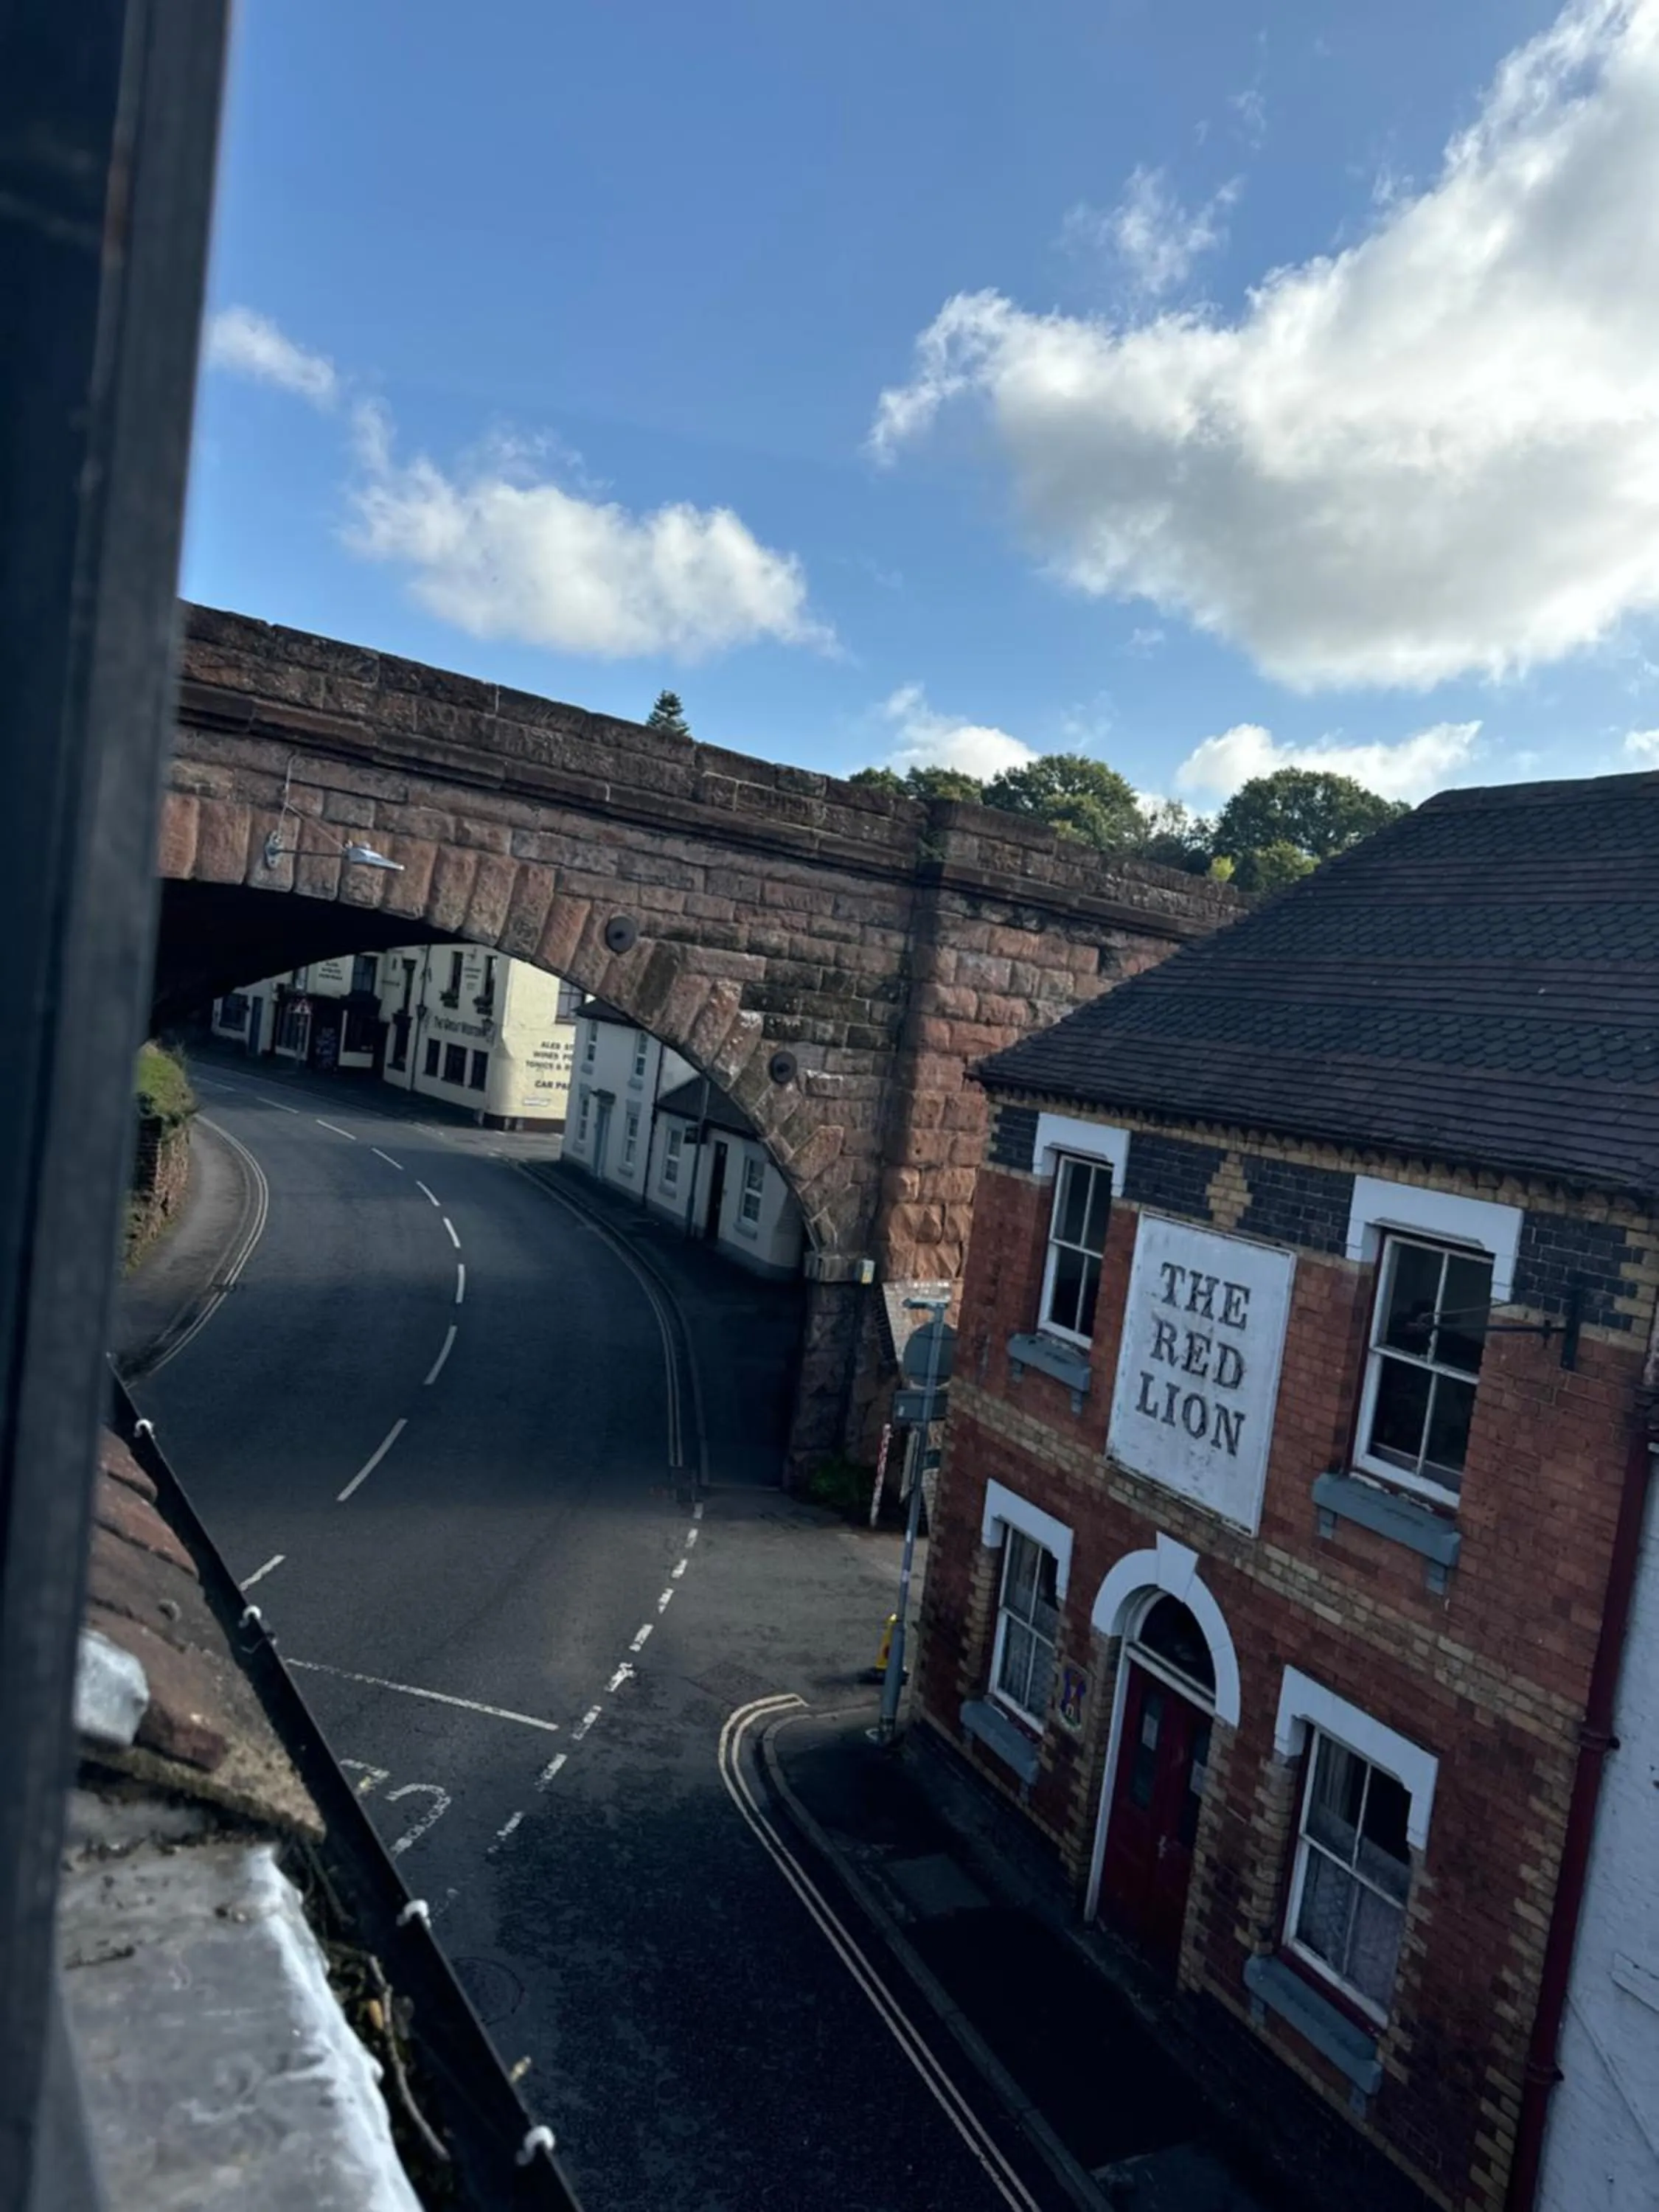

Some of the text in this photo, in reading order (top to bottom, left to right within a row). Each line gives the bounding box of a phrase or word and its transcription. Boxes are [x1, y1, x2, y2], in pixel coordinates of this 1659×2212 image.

[533, 1050, 559, 1060] WINES
[534, 1079, 553, 1089] CAR
[1160, 1262, 1252, 1332] THE
[1149, 1311, 1246, 1391] RED
[1135, 1370, 1246, 1458] LION
